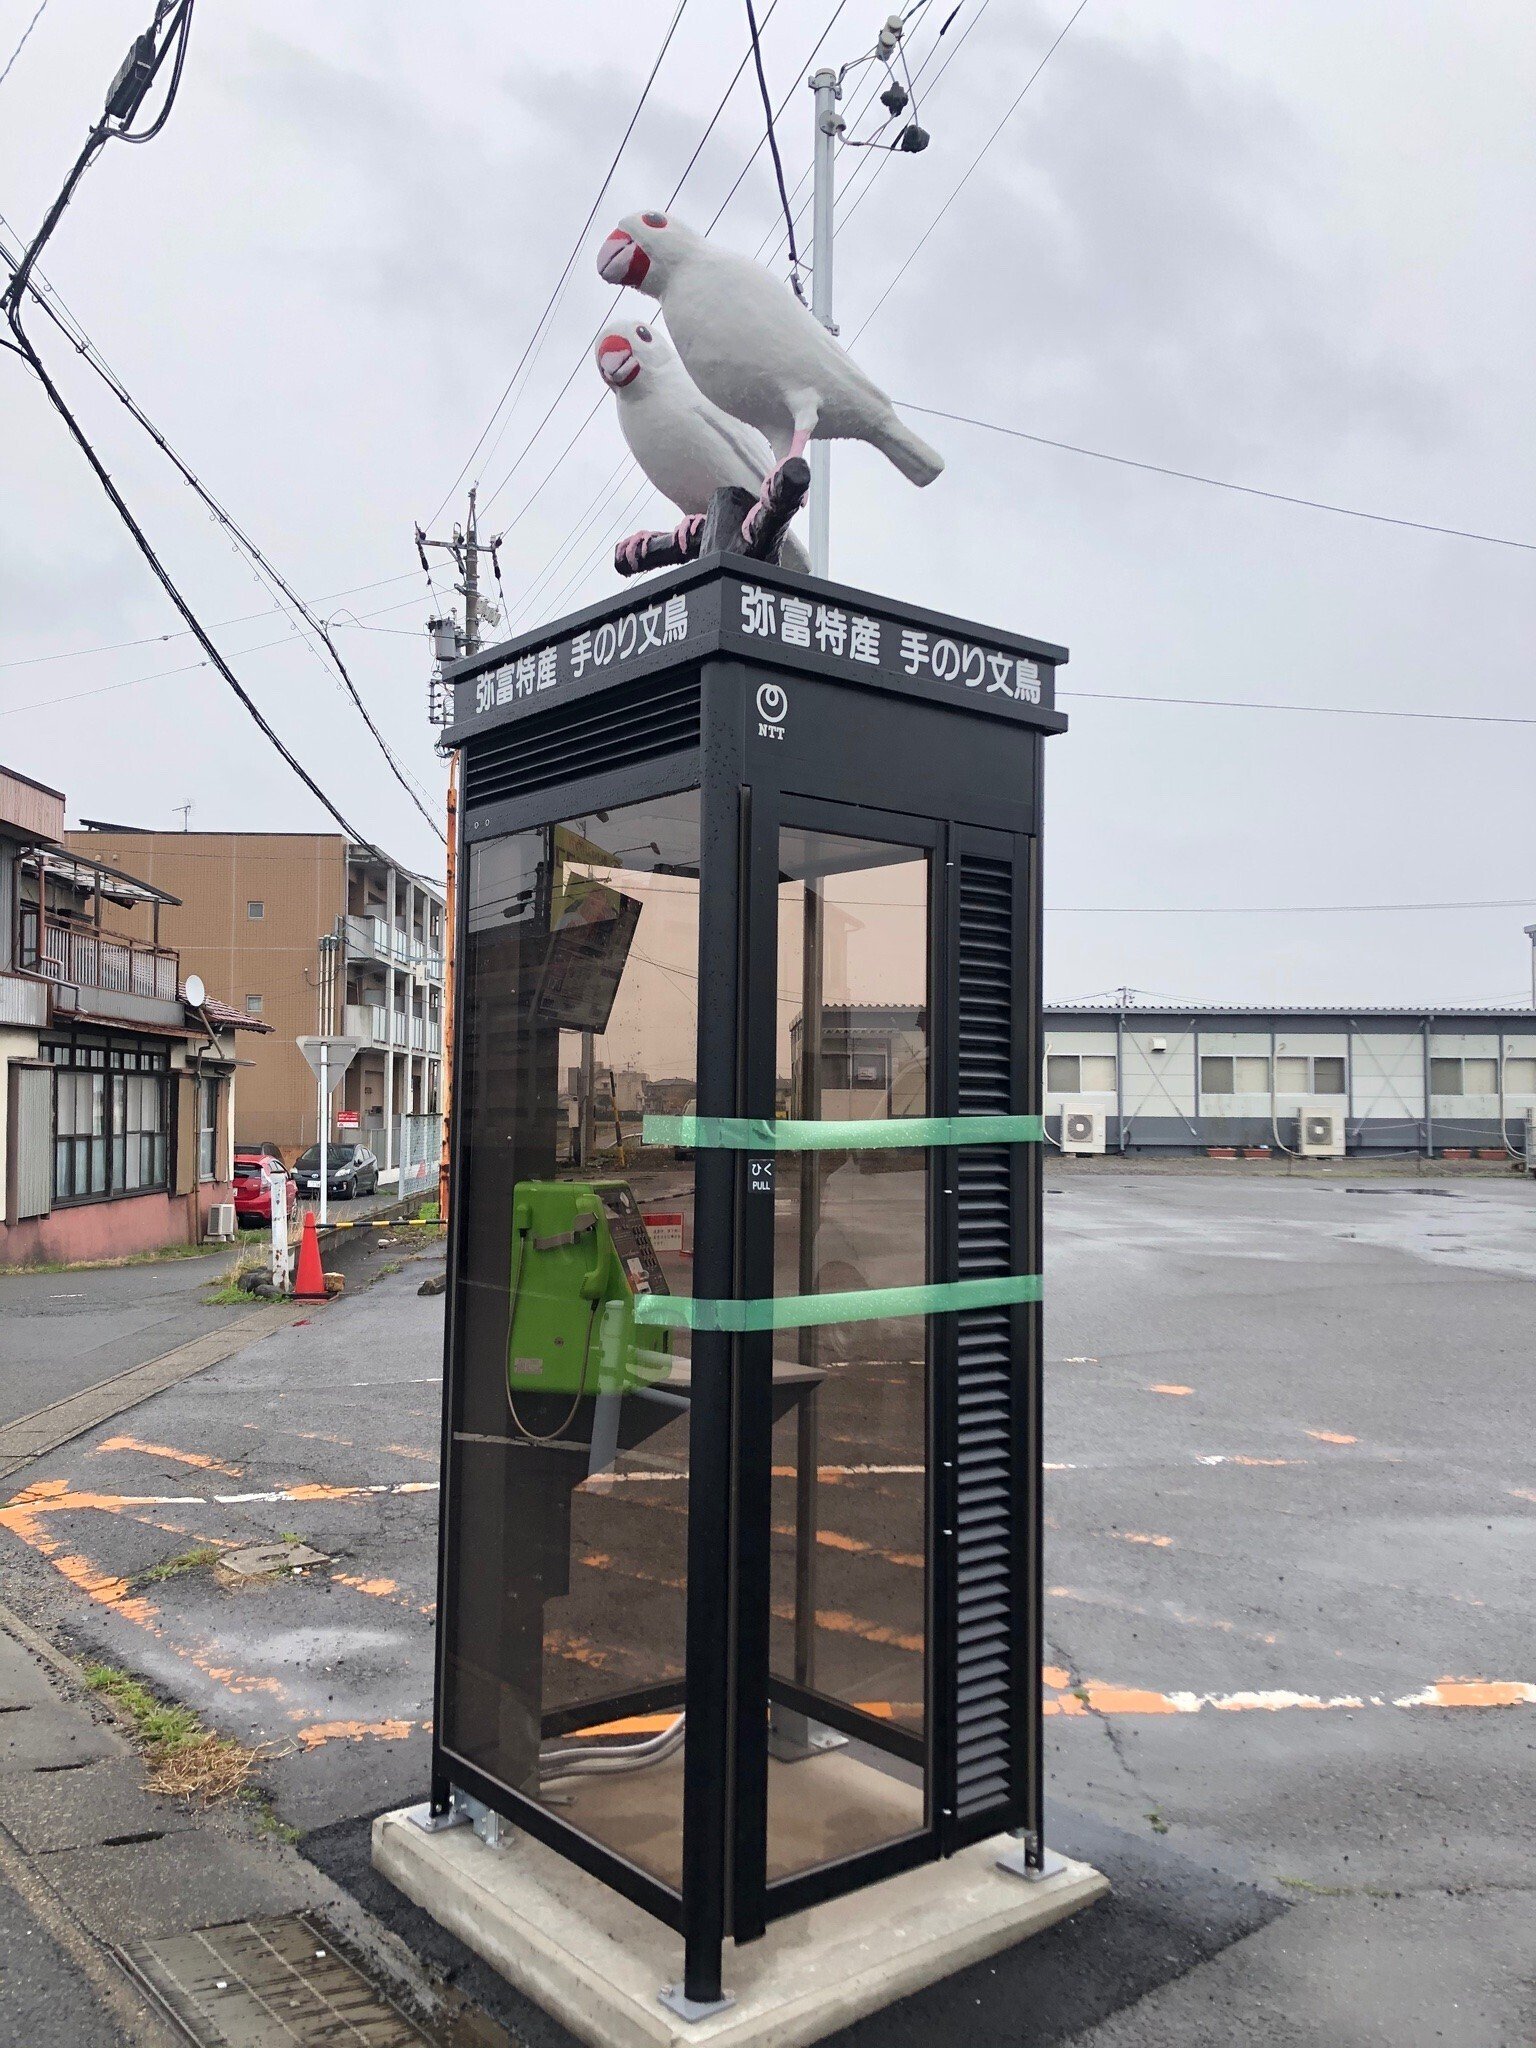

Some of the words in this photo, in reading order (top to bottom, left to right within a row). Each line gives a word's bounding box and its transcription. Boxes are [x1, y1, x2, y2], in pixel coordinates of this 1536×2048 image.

[475, 645, 558, 714] 弥富特産
[570, 593, 689, 678] 手のり文鳥
[741, 585, 881, 665] 弥富特産
[899, 629, 1041, 705] 手のり文鳥
[758, 723, 785, 741] NTT
[751, 1163, 772, 1176] ひく
[752, 1181, 771, 1191] PULL
